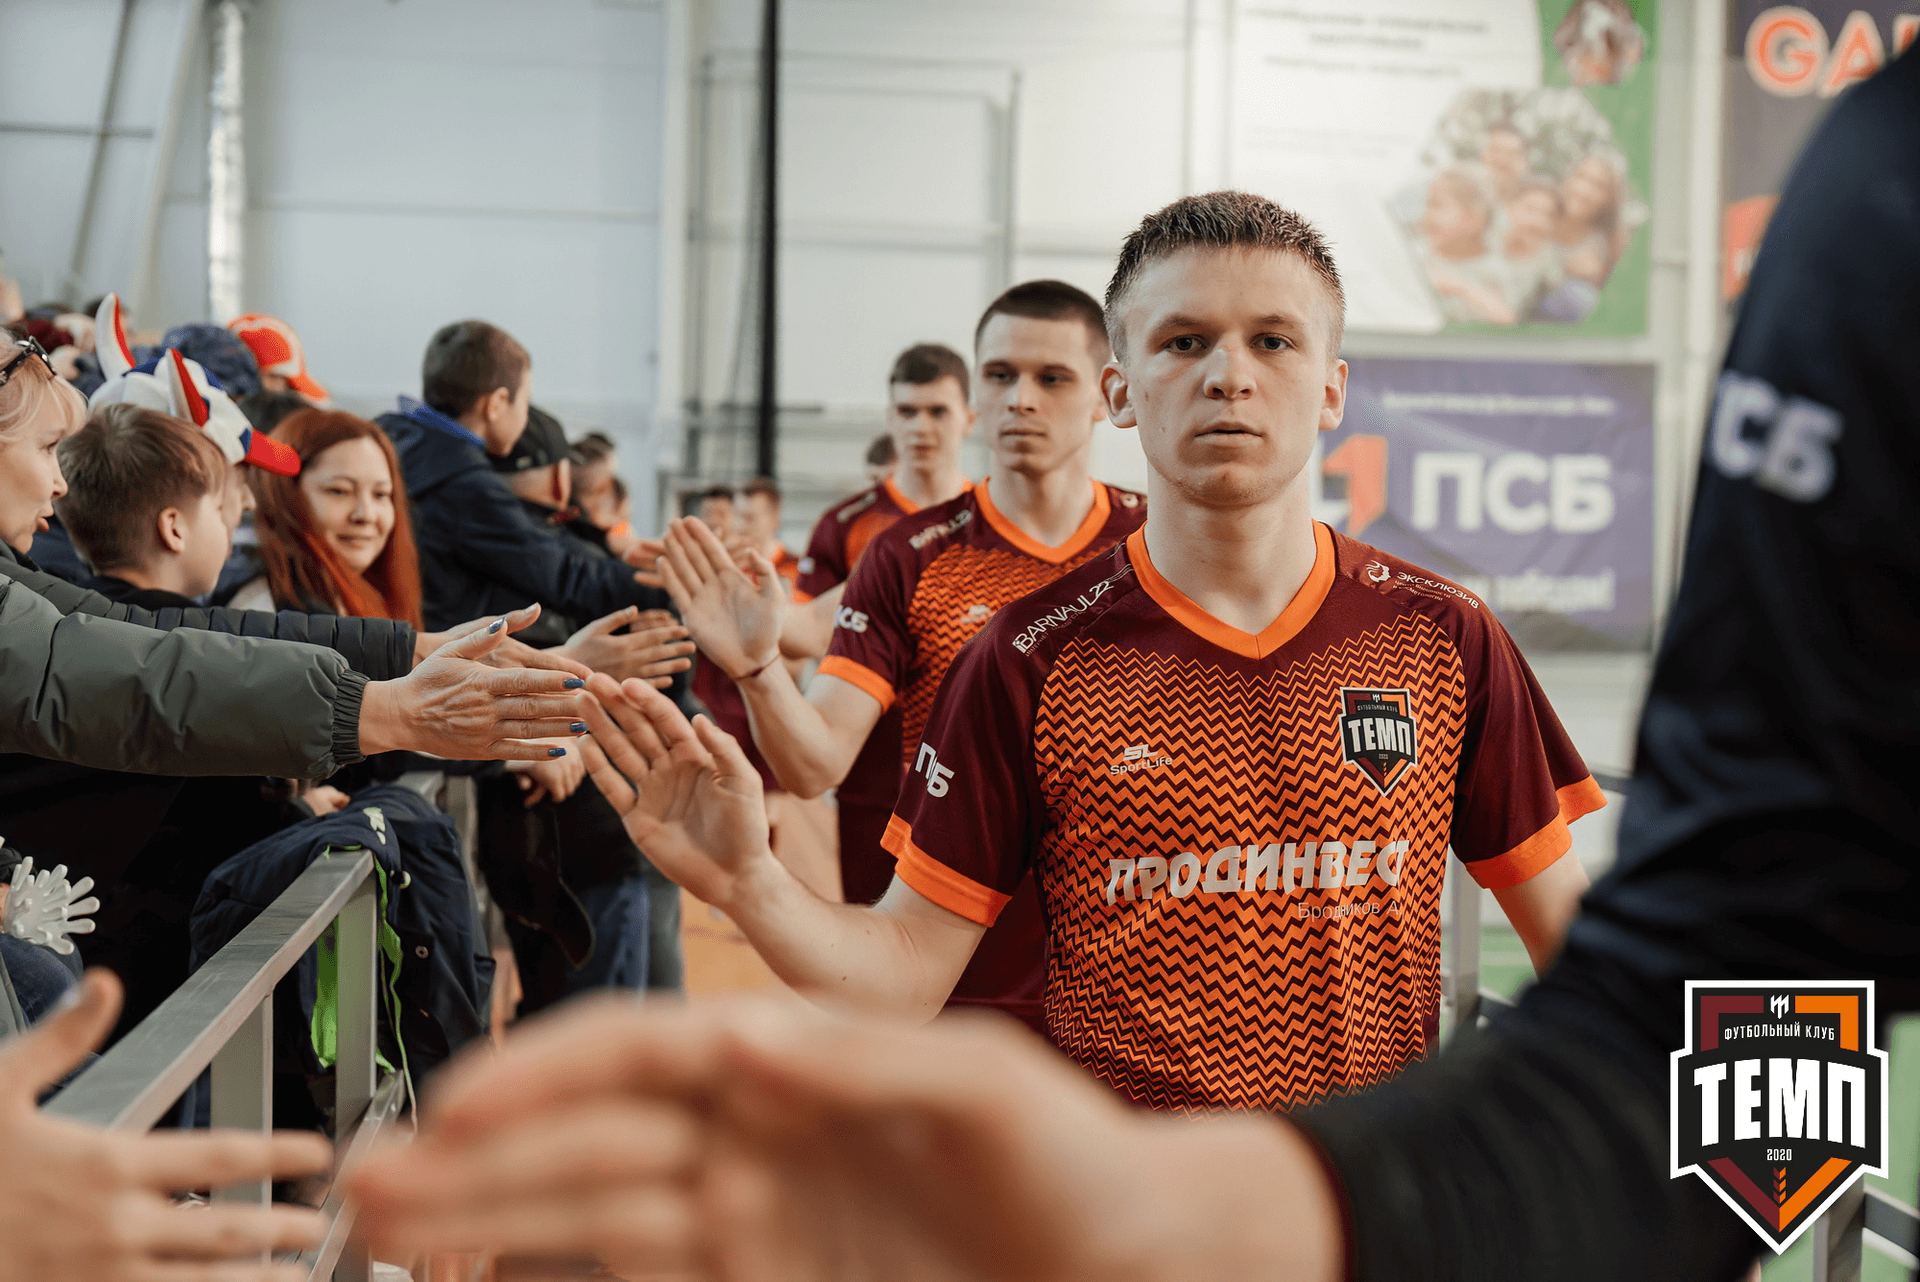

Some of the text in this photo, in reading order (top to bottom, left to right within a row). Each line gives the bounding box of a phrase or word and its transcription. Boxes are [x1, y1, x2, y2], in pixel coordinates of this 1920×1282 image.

[1744, 6, 1920, 98] GA
[1711, 373, 1843, 500] СБ
[1411, 450, 1615, 534] ПСБ
[1397, 571, 1479, 609] ЭКСКЛЮЗИВ
[1347, 717, 1412, 756] ТЕМП
[915, 741, 955, 798] ПБ
[1110, 756, 1173, 775] SportLife
